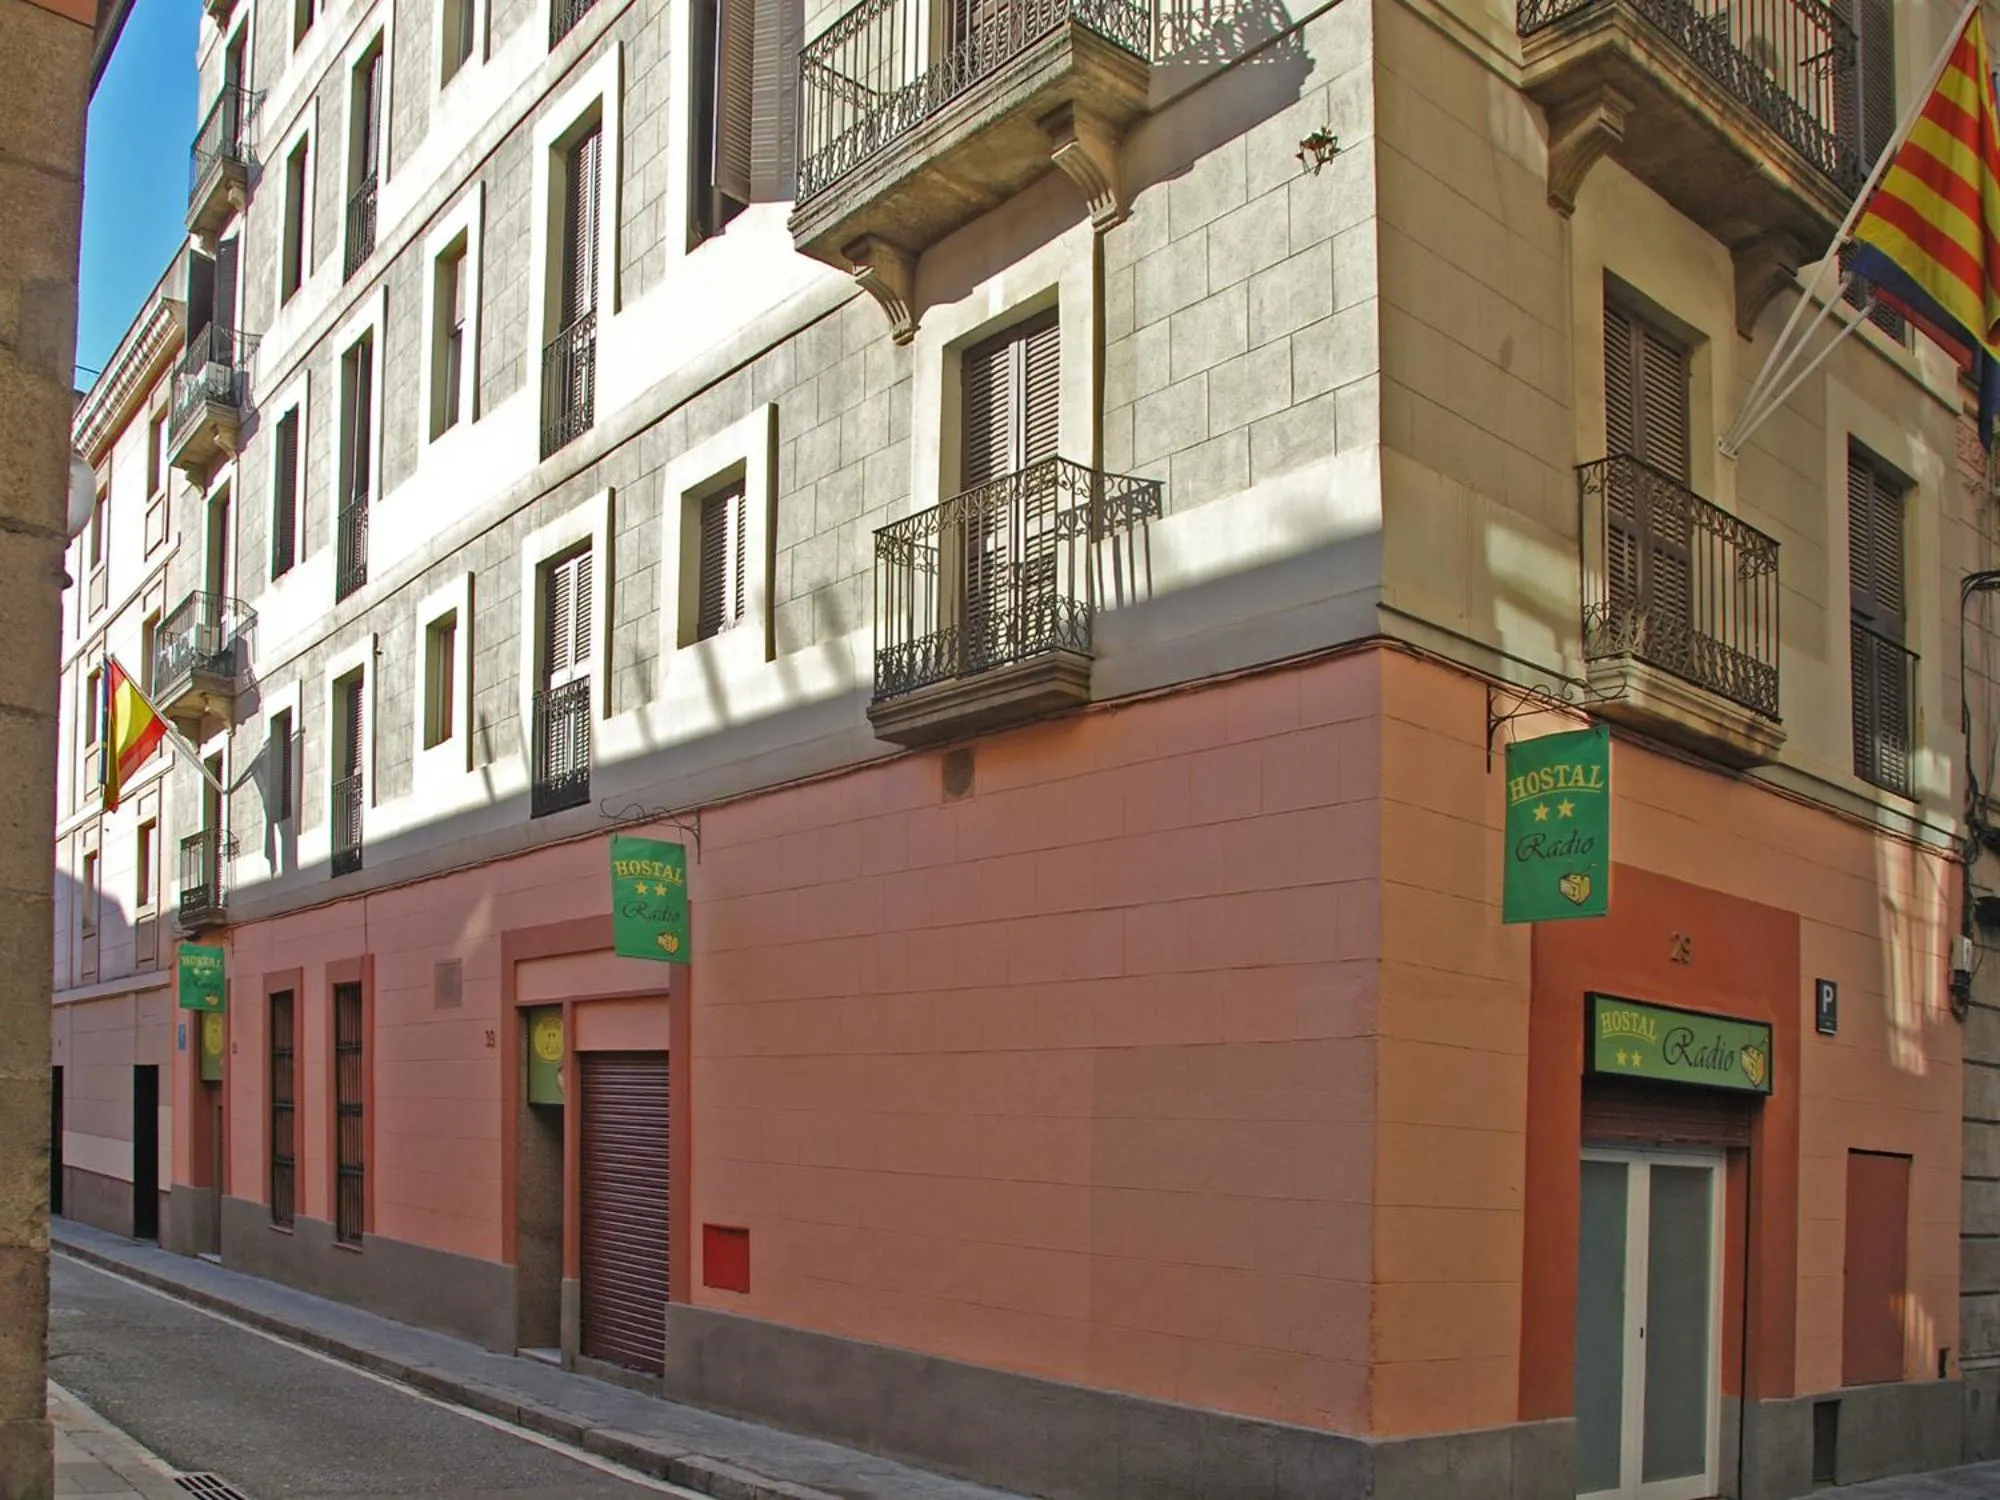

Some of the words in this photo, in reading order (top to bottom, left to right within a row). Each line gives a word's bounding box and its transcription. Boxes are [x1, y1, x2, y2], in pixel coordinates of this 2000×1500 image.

[1508, 764, 1605, 801] HOSTAL
[1515, 829, 1595, 862] Radio
[613, 860, 684, 882] HOSTAL
[622, 901, 680, 923] Radio
[1822, 984, 1834, 1013] P
[1600, 1010, 1658, 1040] HOSTAL
[1662, 1027, 1735, 1072] Radio
